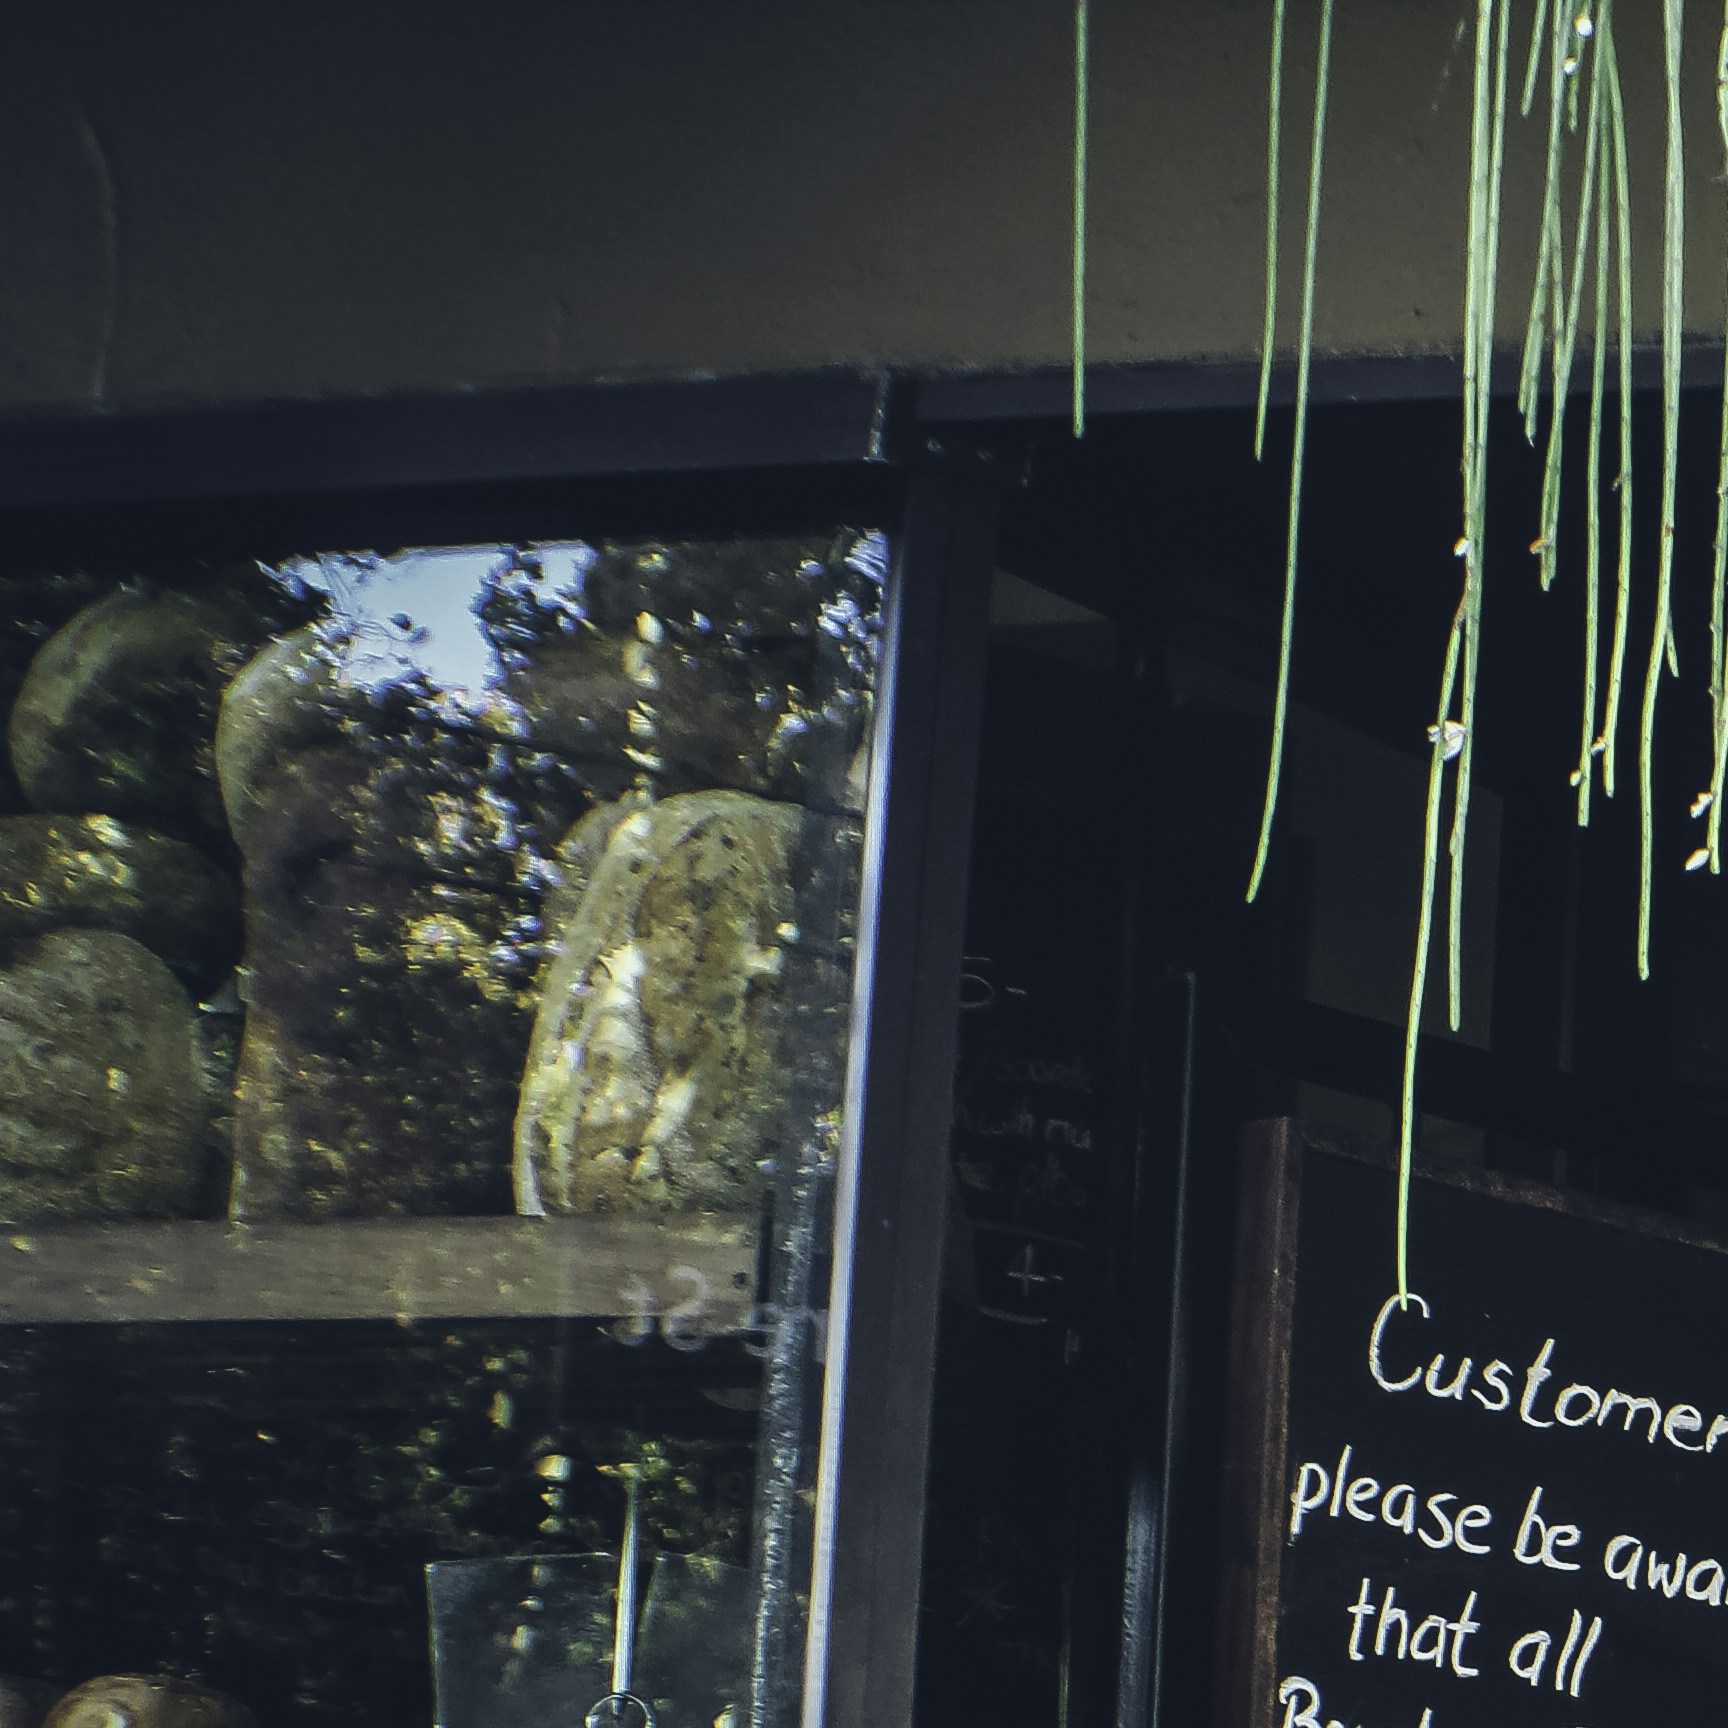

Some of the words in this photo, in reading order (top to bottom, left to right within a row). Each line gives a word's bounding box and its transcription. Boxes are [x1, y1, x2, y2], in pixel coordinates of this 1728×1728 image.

[1289, 1445, 1491, 1554] please
[1514, 1486, 1581, 1570] be
[1348, 1578, 1479, 1676] that
[1509, 1609, 1602, 1697] all
